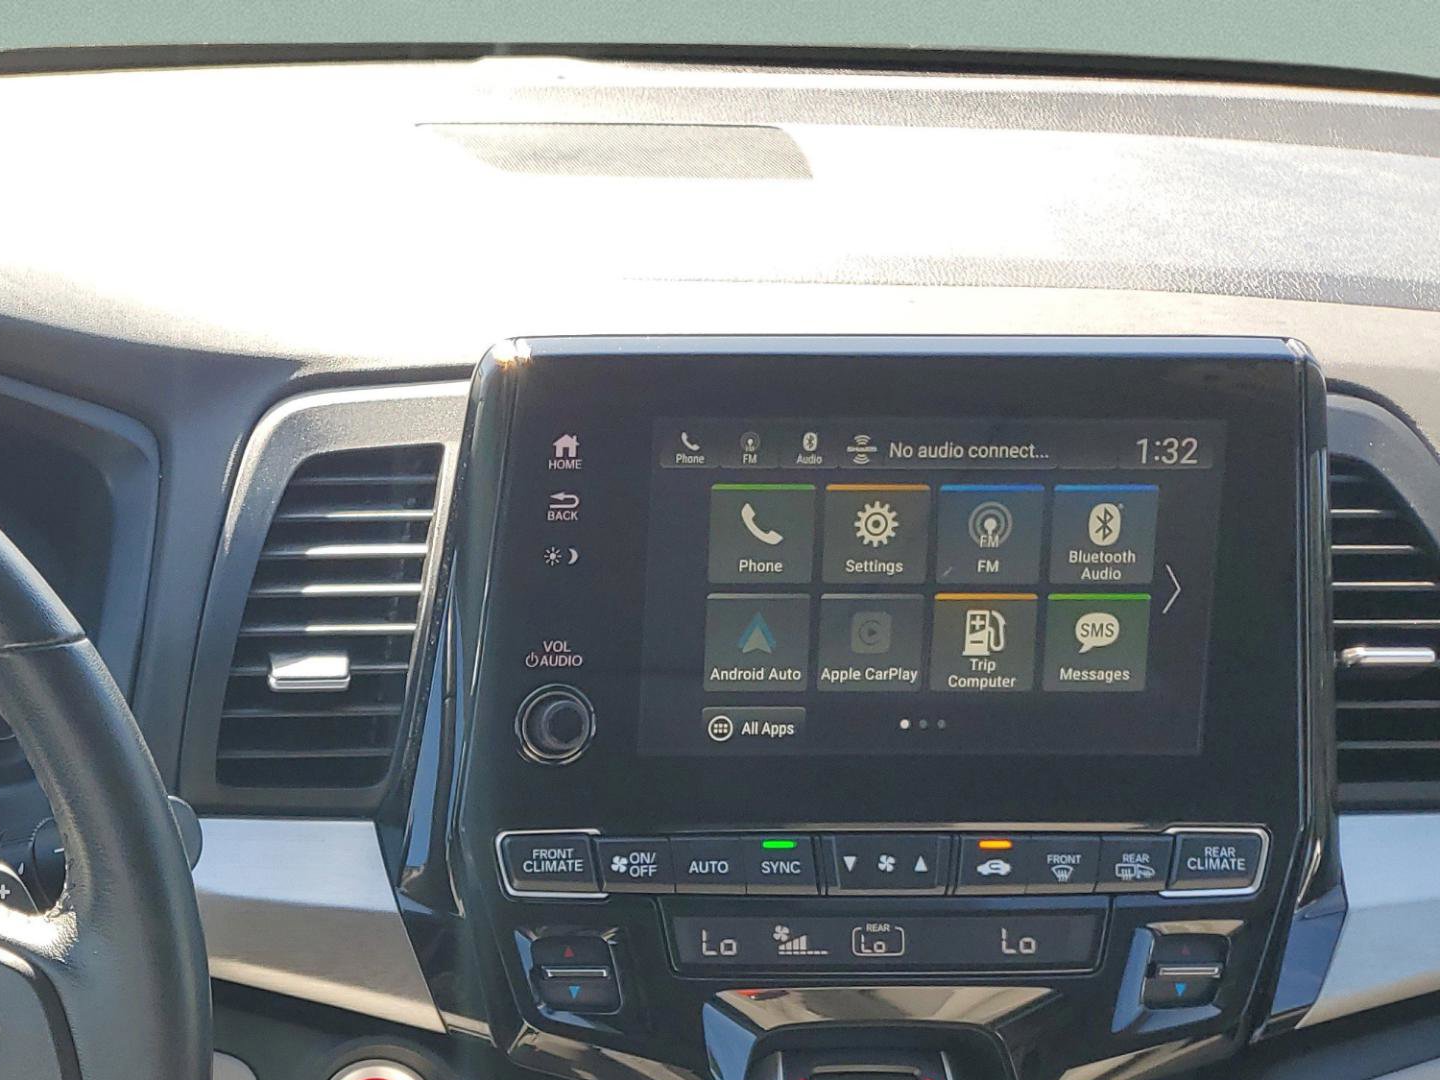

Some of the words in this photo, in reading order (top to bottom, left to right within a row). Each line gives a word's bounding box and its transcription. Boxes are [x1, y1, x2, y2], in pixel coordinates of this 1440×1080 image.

[889, 443, 913, 458] No
[918, 443, 964, 458] audio
[968, 443, 1050, 459] connect...
[1135, 437, 1199, 465] 1:32
[548, 459, 583, 470] HOME
[675, 454, 705, 465] Phone
[742, 453, 758, 465] FM
[796, 453, 823, 465] Audio
[547, 510, 579, 522] BACK
[1068, 550, 1136, 564] Bluetooth
[739, 560, 784, 573] Phone
[845, 560, 904, 576] Settings
[977, 560, 1000, 573] FM
[1080, 567, 1122, 581] Audio
[1079, 623, 1115, 638] SMS
[543, 641, 572, 653] VOL
[540, 655, 583, 668] AUDIO
[970, 658, 997, 673] Trip
[710, 667, 765, 681] Android
[768, 667, 802, 681] Auto
[821, 667, 862, 684] Apple
[865, 667, 919, 684] CarPlay
[1059, 667, 1131, 684] Messages
[948, 674, 1017, 691] Computer
[741, 722, 759, 736] All
[761, 722, 795, 738] Apps
[532, 848, 575, 861] FRONT
[629, 852, 657, 866] ON/
[1122, 853, 1151, 864] REAR
[1203, 846, 1236, 858] REAR
[523, 859, 584, 873] CLIMATE
[1046, 854, 1082, 866] FRONT
[1186, 857, 1247, 872] CLIMATE
[629, 865, 658, 878] OFF
[689, 860, 729, 875] AUTO
[761, 860, 801, 875] SYNC
[866, 923, 891, 932] REAR
